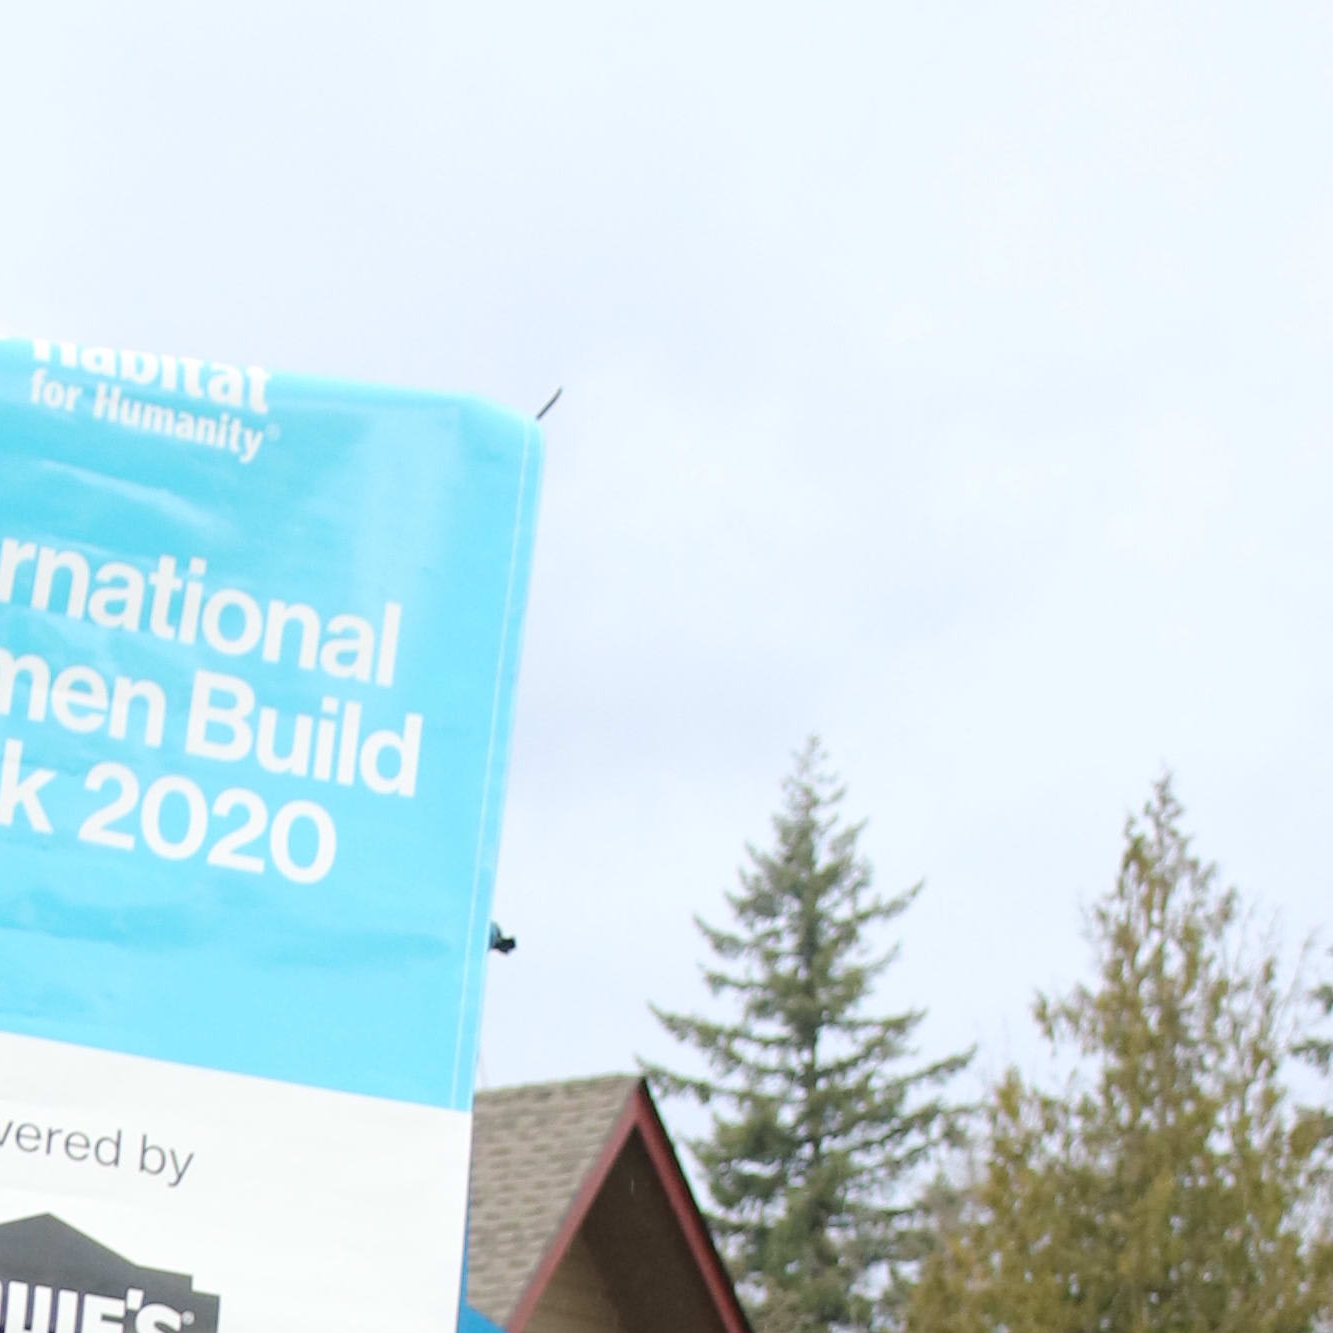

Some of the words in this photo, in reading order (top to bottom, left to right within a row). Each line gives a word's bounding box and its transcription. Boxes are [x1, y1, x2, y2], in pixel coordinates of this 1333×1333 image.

[31, 367, 83, 412] for
[92, 382, 265, 463] Humanity
[184, 669, 425, 798] Build
[77, 761, 338, 885] 2020
[137, 1133, 195, 1190] by
